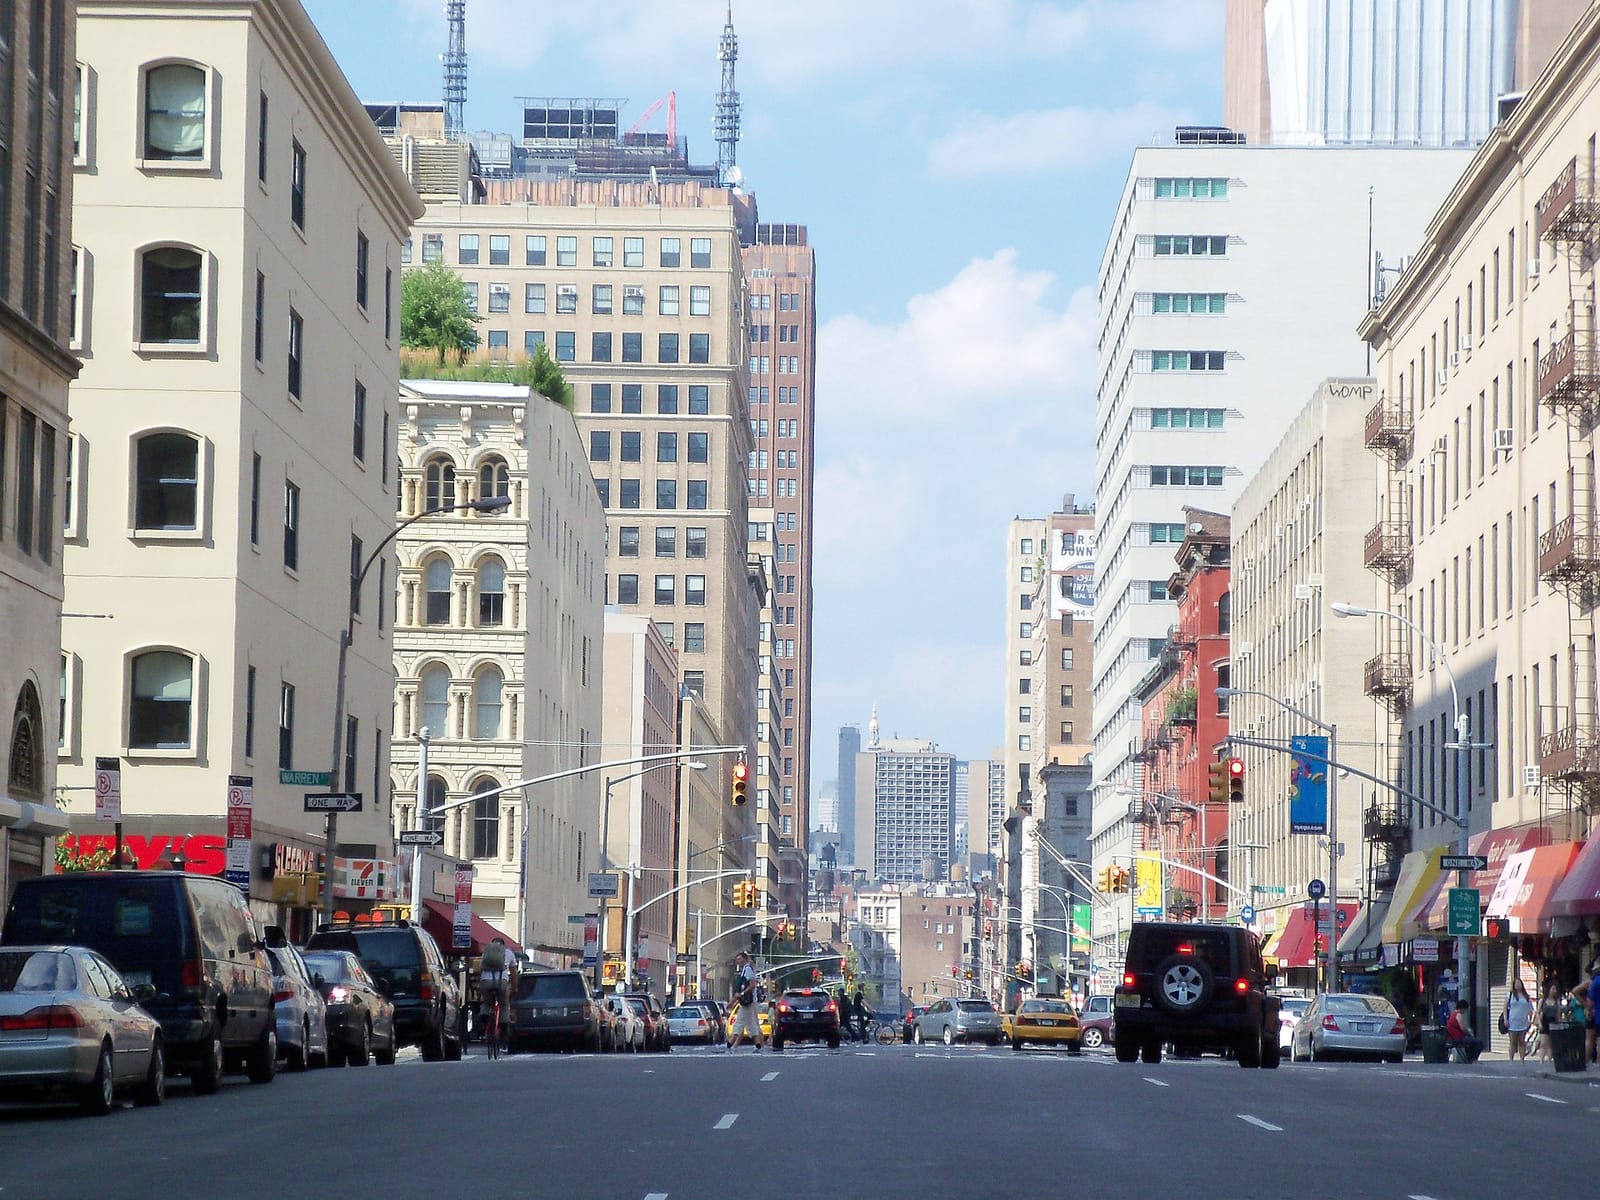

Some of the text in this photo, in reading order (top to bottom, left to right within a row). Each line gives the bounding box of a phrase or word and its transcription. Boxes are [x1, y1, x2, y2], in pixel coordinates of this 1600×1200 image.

[1329, 384, 1373, 400] WOMP
[281, 772, 319, 784] WARREN
[311, 798, 355, 808] ONE WAY
[425, 834, 438, 842] WAY
[1446, 859, 1481, 867] ONE WAY
